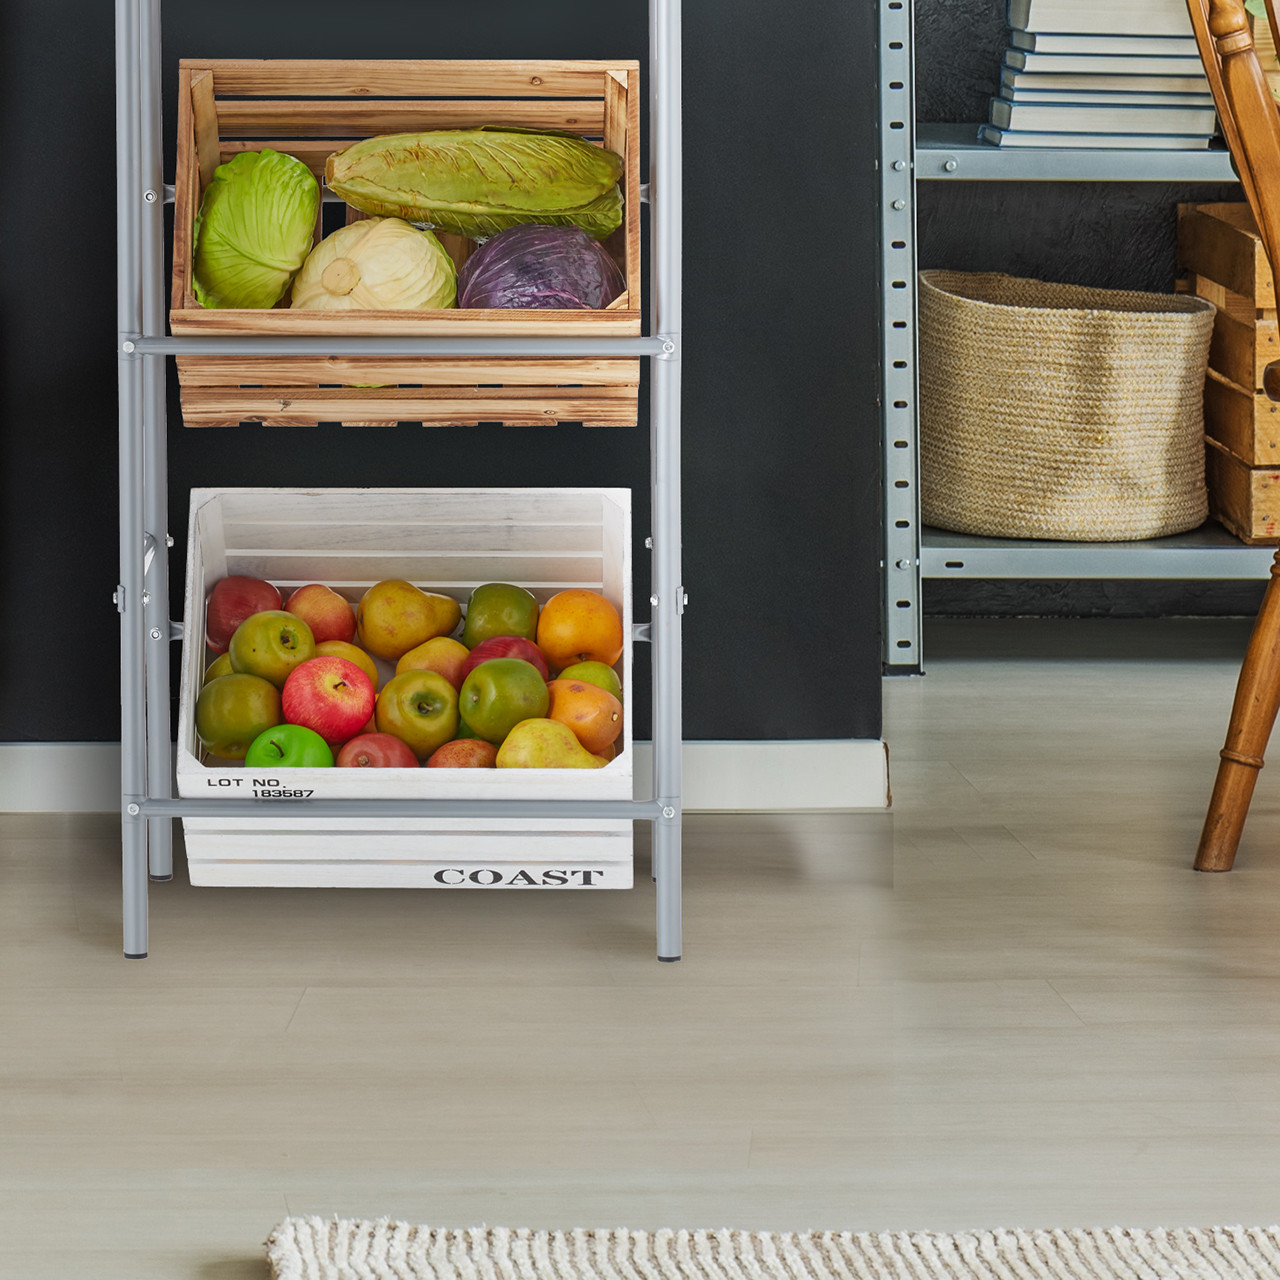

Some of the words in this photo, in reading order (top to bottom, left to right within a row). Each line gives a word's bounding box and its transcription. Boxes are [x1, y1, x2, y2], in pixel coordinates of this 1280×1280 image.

[207, 778, 244, 787] LOT
[252, 778, 286, 789] NO.
[252, 789, 315, 798] 183587
[433, 868, 604, 886] COAST
